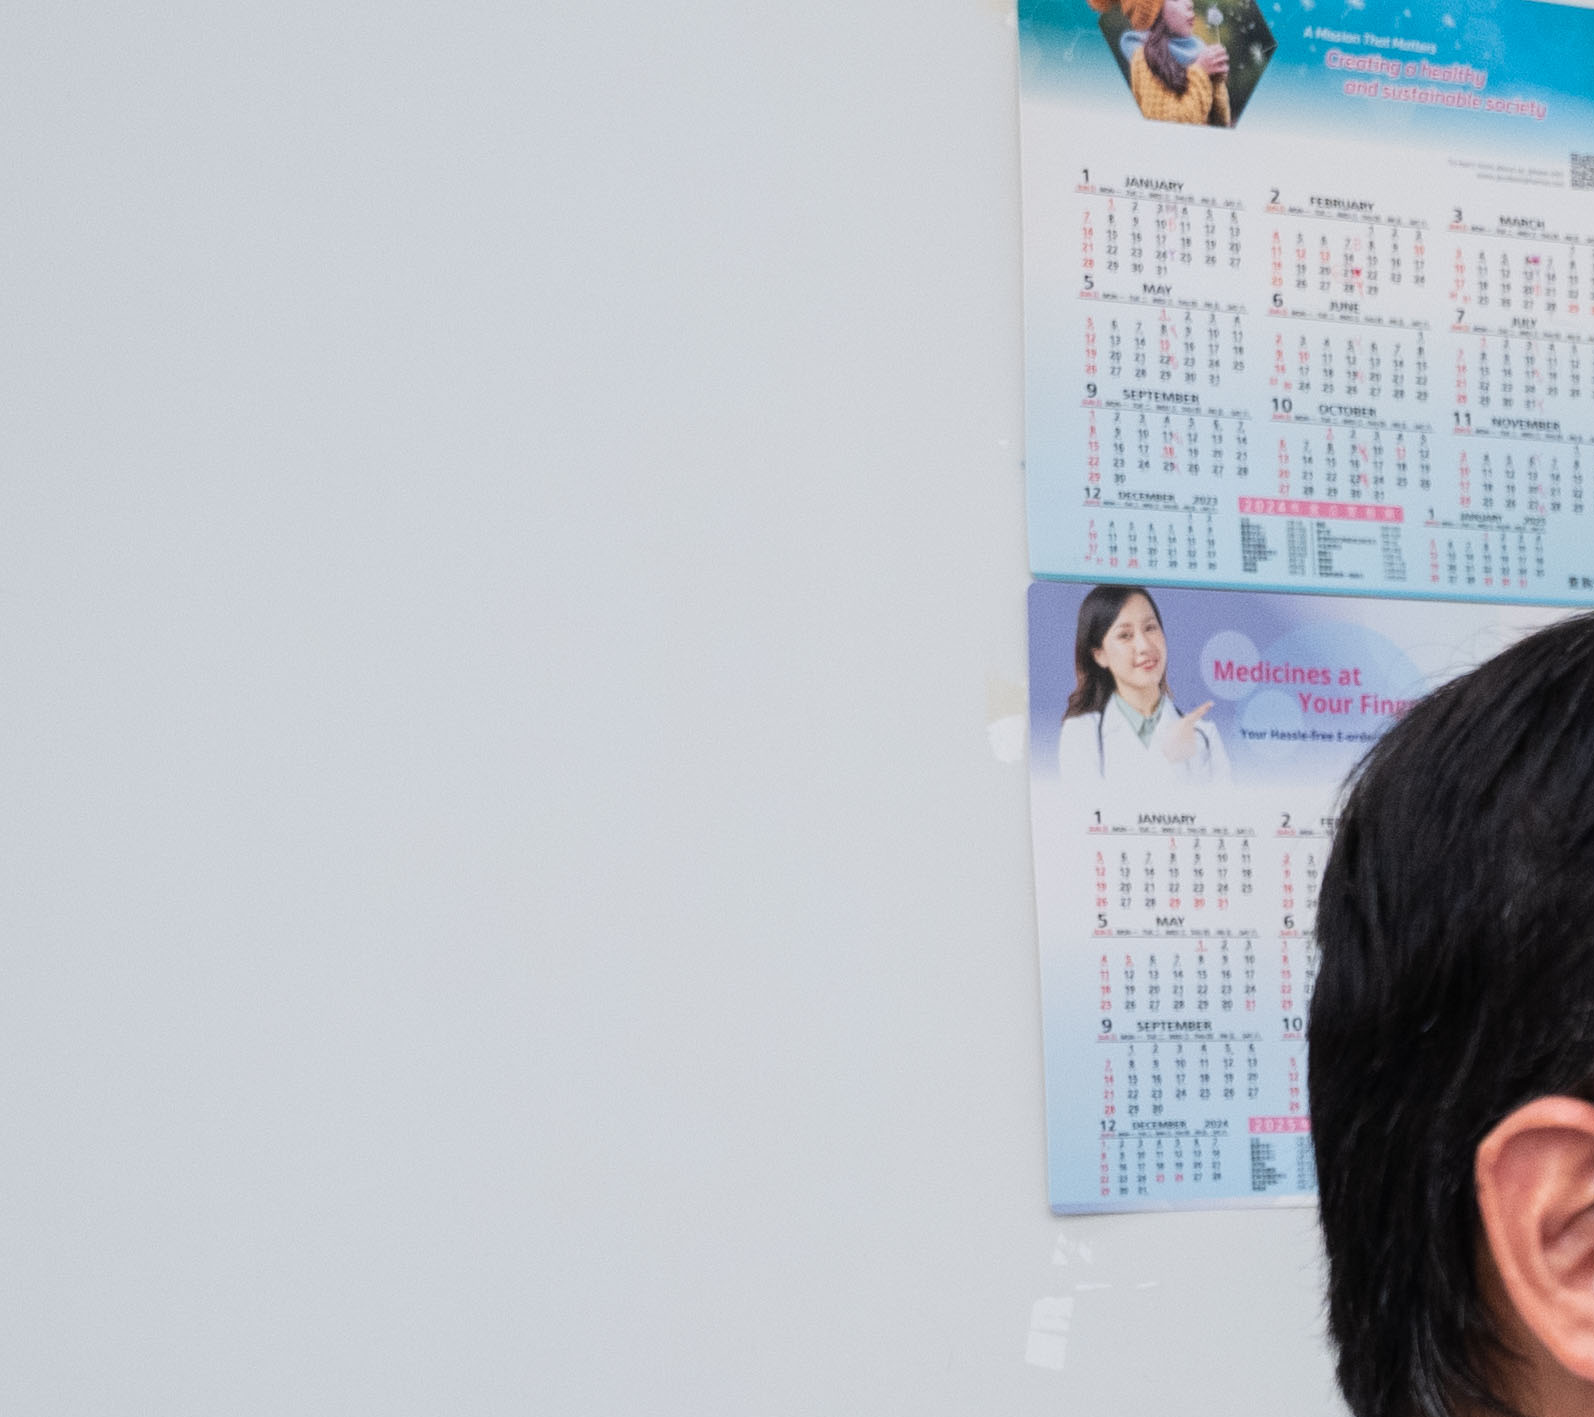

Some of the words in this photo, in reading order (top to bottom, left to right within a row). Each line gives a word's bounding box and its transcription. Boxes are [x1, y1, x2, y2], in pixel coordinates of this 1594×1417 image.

[1394, 37, 1437, 54] Matters
[1326, 49, 1401, 77] Creating
[1421, 62, 1487, 88] healthy
[1344, 79, 1378, 97] and
[1382, 84, 1481, 110] sustainable
[1486, 96, 1546, 120] society
[1125, 176, 1183, 191] JANUARY
[1143, 283, 1172, 295] MAY
[1123, 389, 1199, 403] SEPTEMBER
[1319, 404, 1377, 417] OCTOBER
[1214, 660, 1331, 685] Medicines
[1339, 668, 1362, 686] at
[1298, 692, 1352, 714] Your
[1138, 814, 1196, 825] JANUARY
[1156, 917, 1185, 926] MAY
[1137, 1021, 1212, 1031] SEPTEMBER
